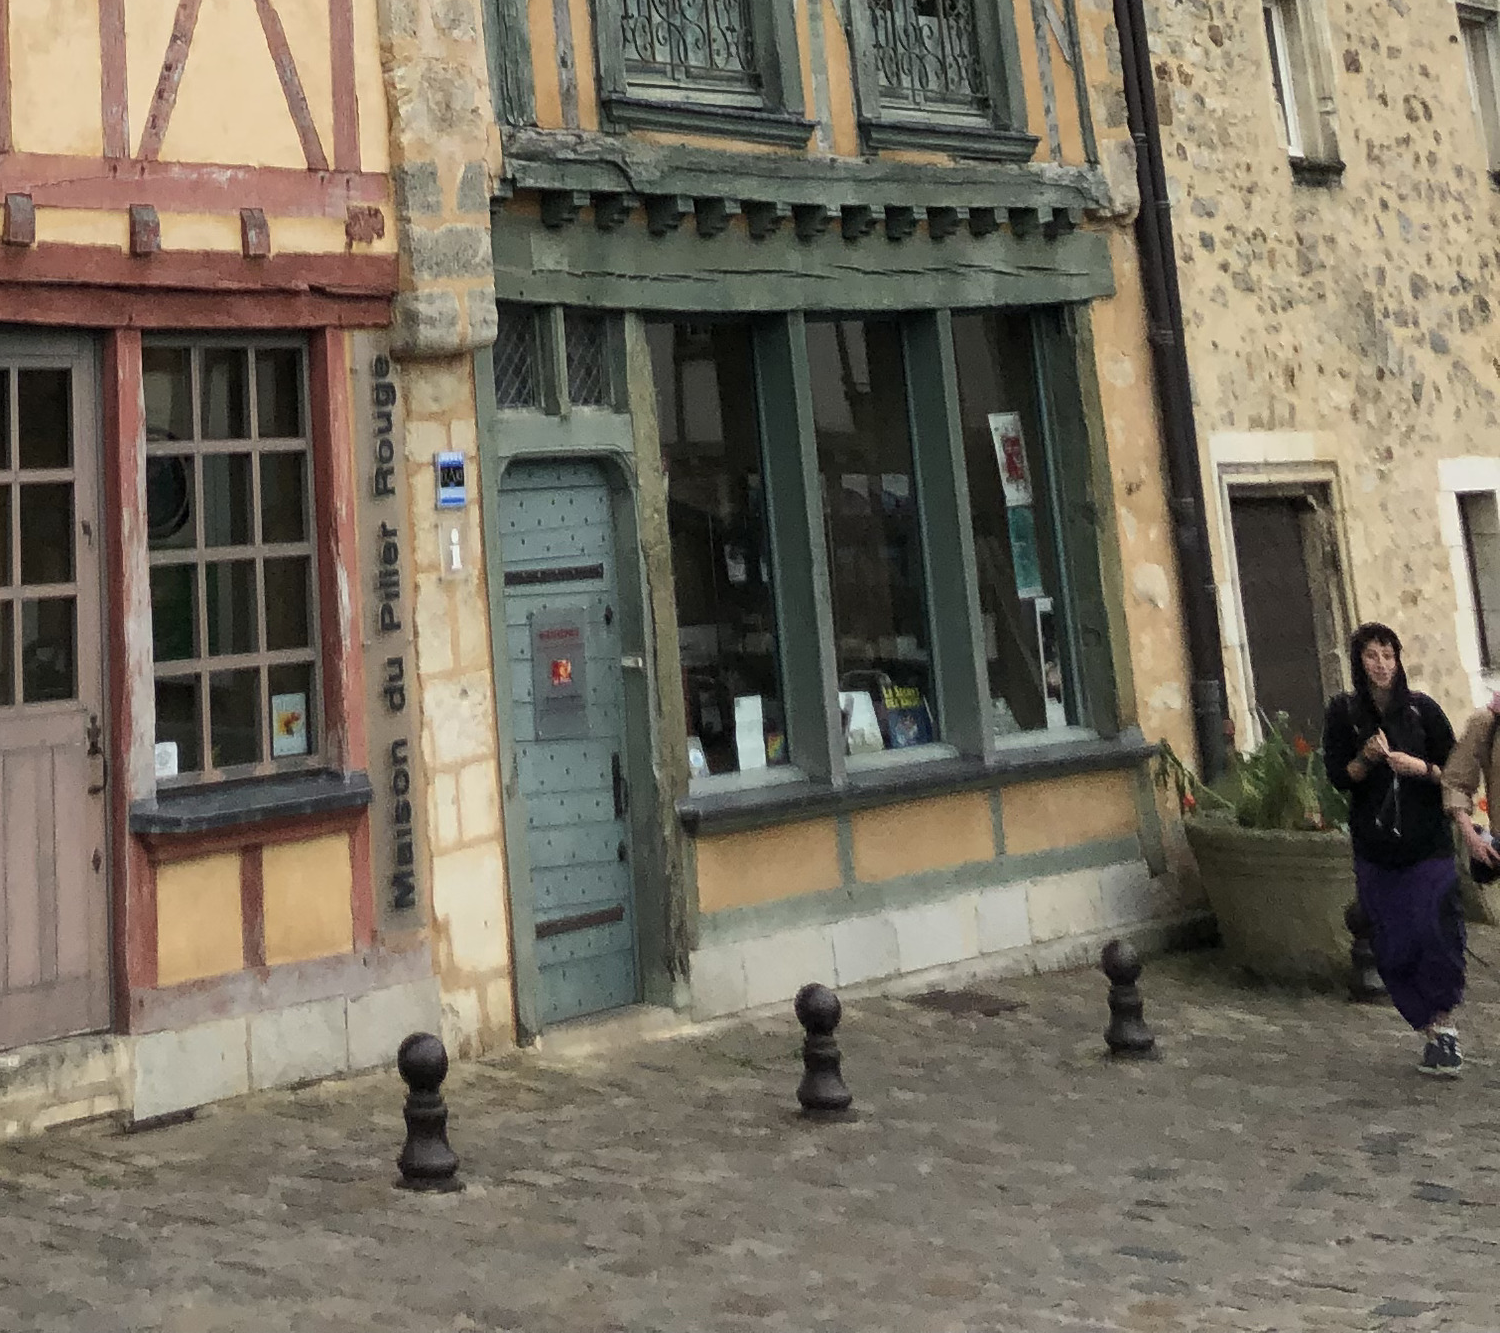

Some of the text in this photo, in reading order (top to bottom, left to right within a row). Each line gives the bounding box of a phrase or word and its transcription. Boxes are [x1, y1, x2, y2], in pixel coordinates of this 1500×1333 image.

[373, 354, 416, 909] Maison du Pilier Rouge
